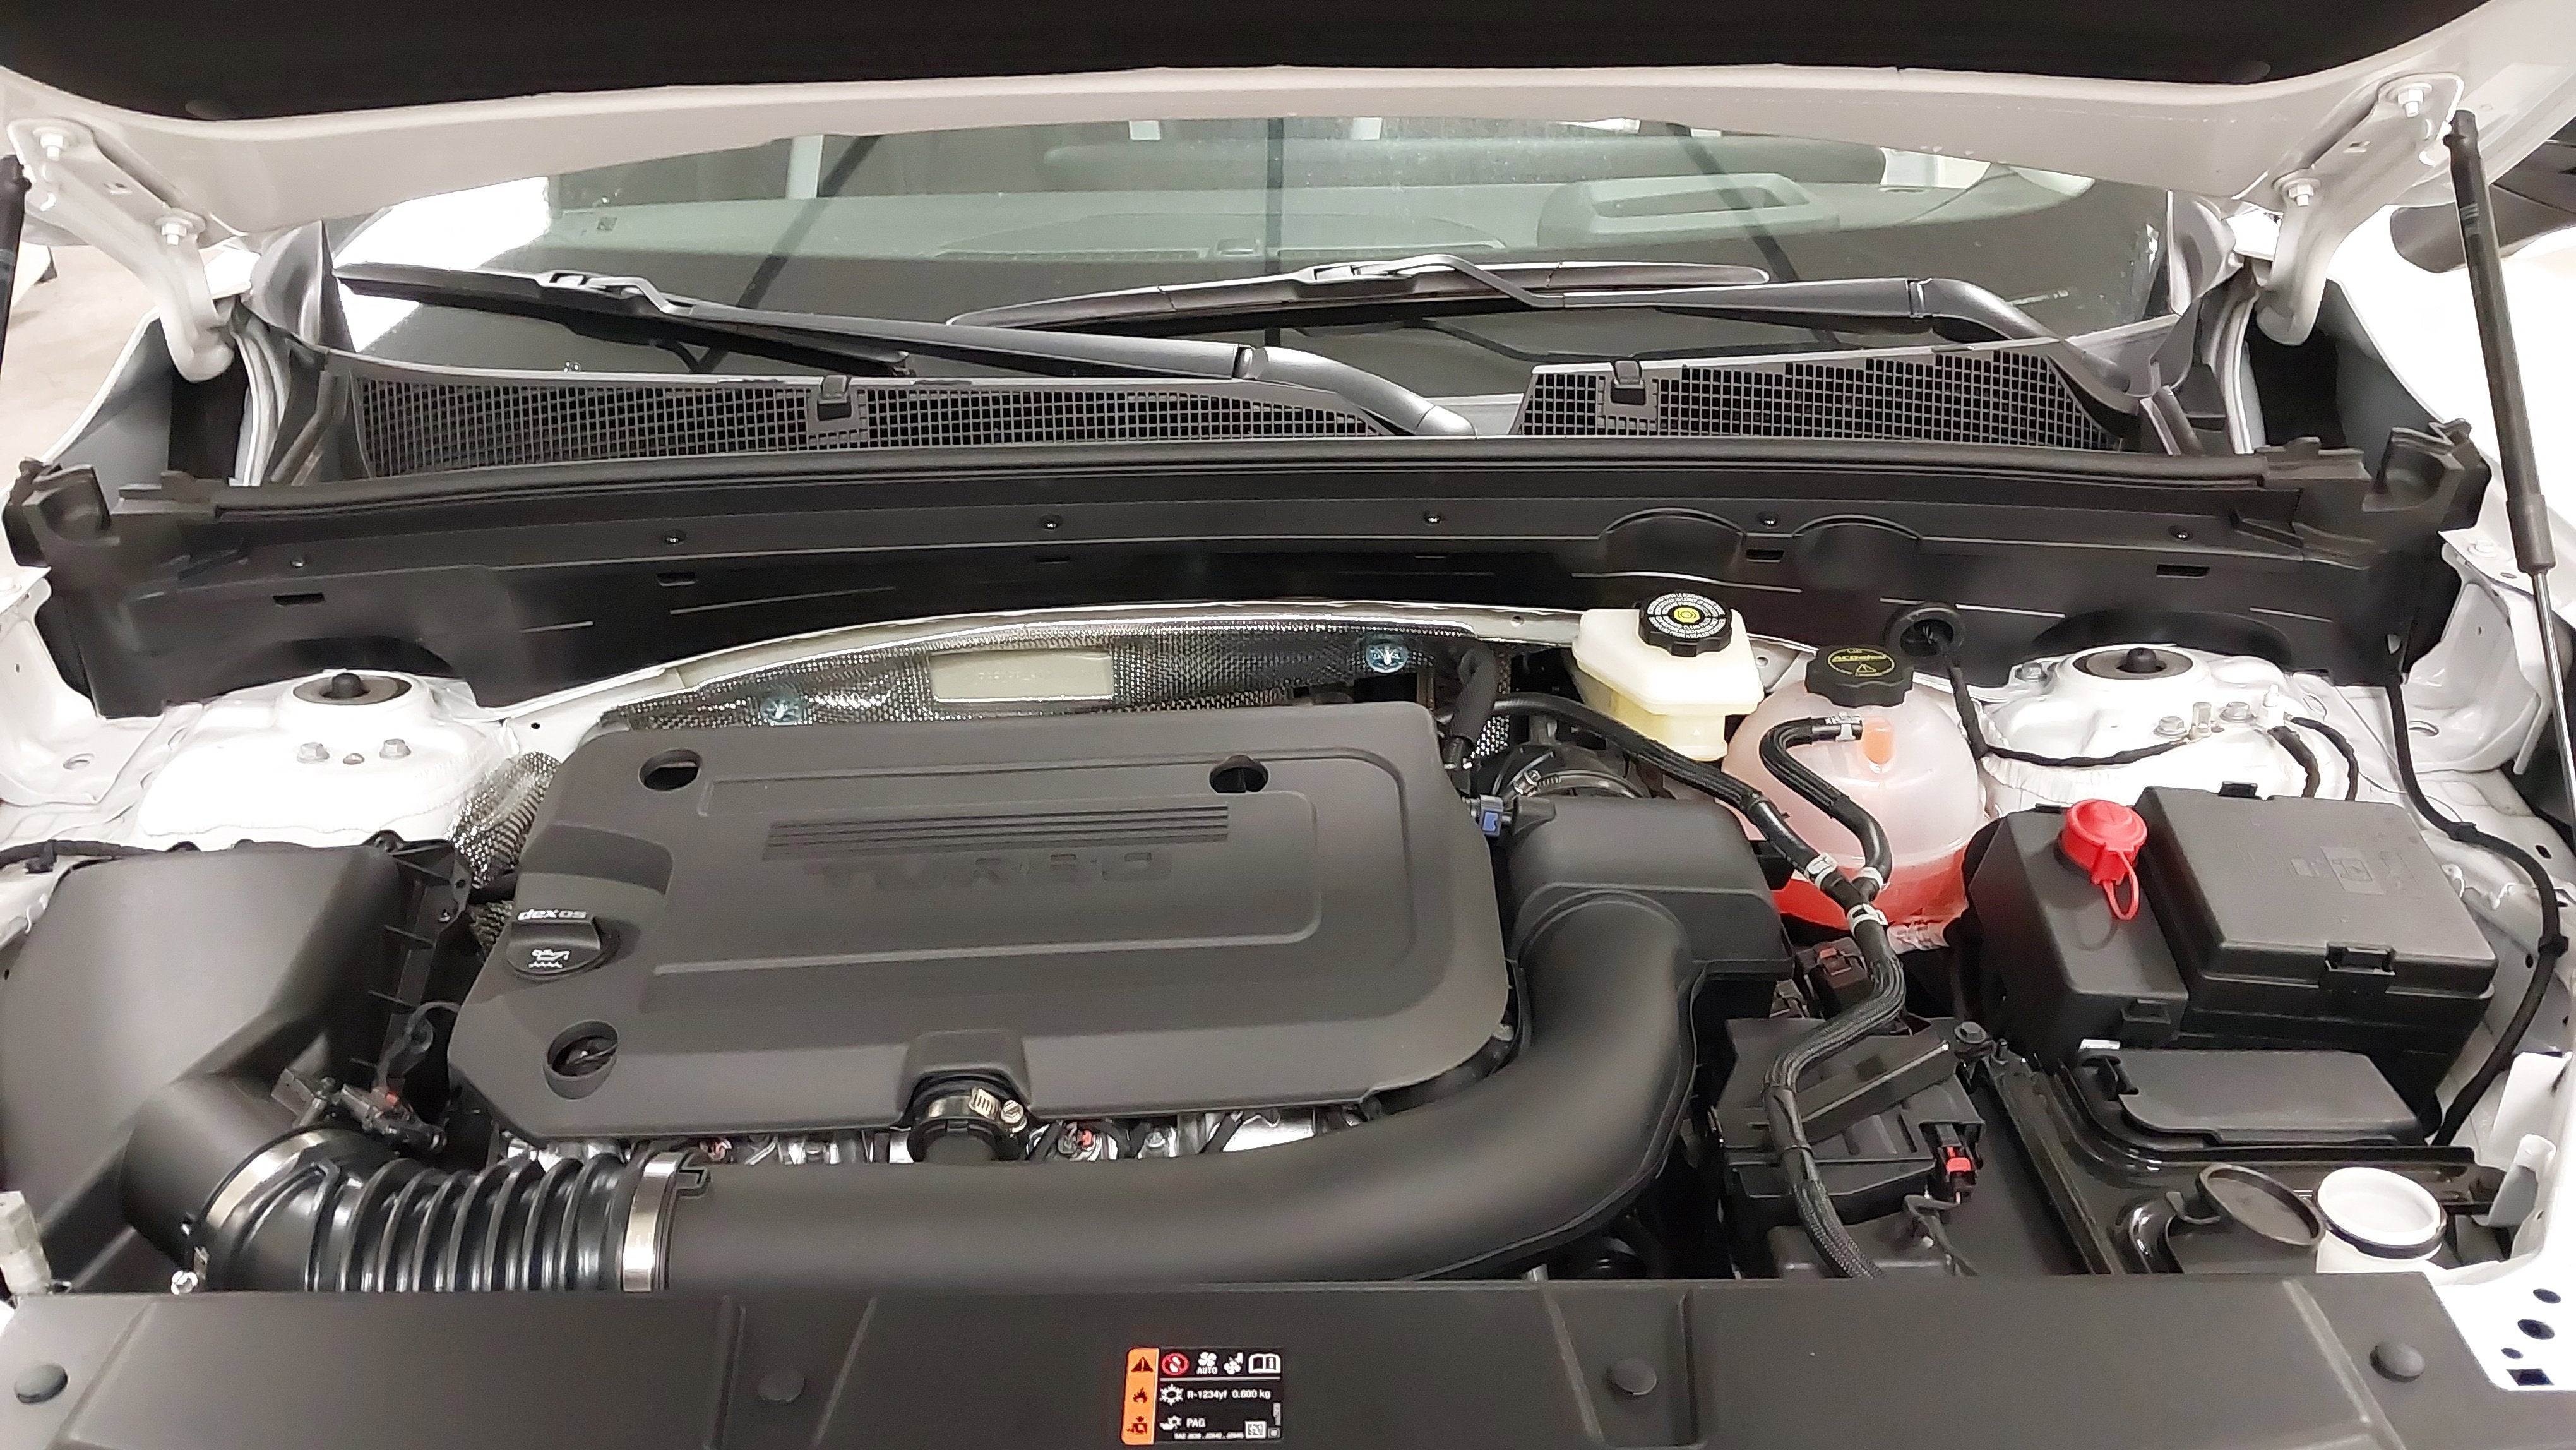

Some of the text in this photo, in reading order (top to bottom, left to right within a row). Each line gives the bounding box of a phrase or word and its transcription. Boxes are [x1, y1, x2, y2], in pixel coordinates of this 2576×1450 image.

[803, 851, 1172, 891] TURBO
[518, 909, 586, 920] dexos
[1187, 1389, 1271, 1400] R-1234yf 0.600 kg
[1186, 1418, 1206, 1428] PAG
